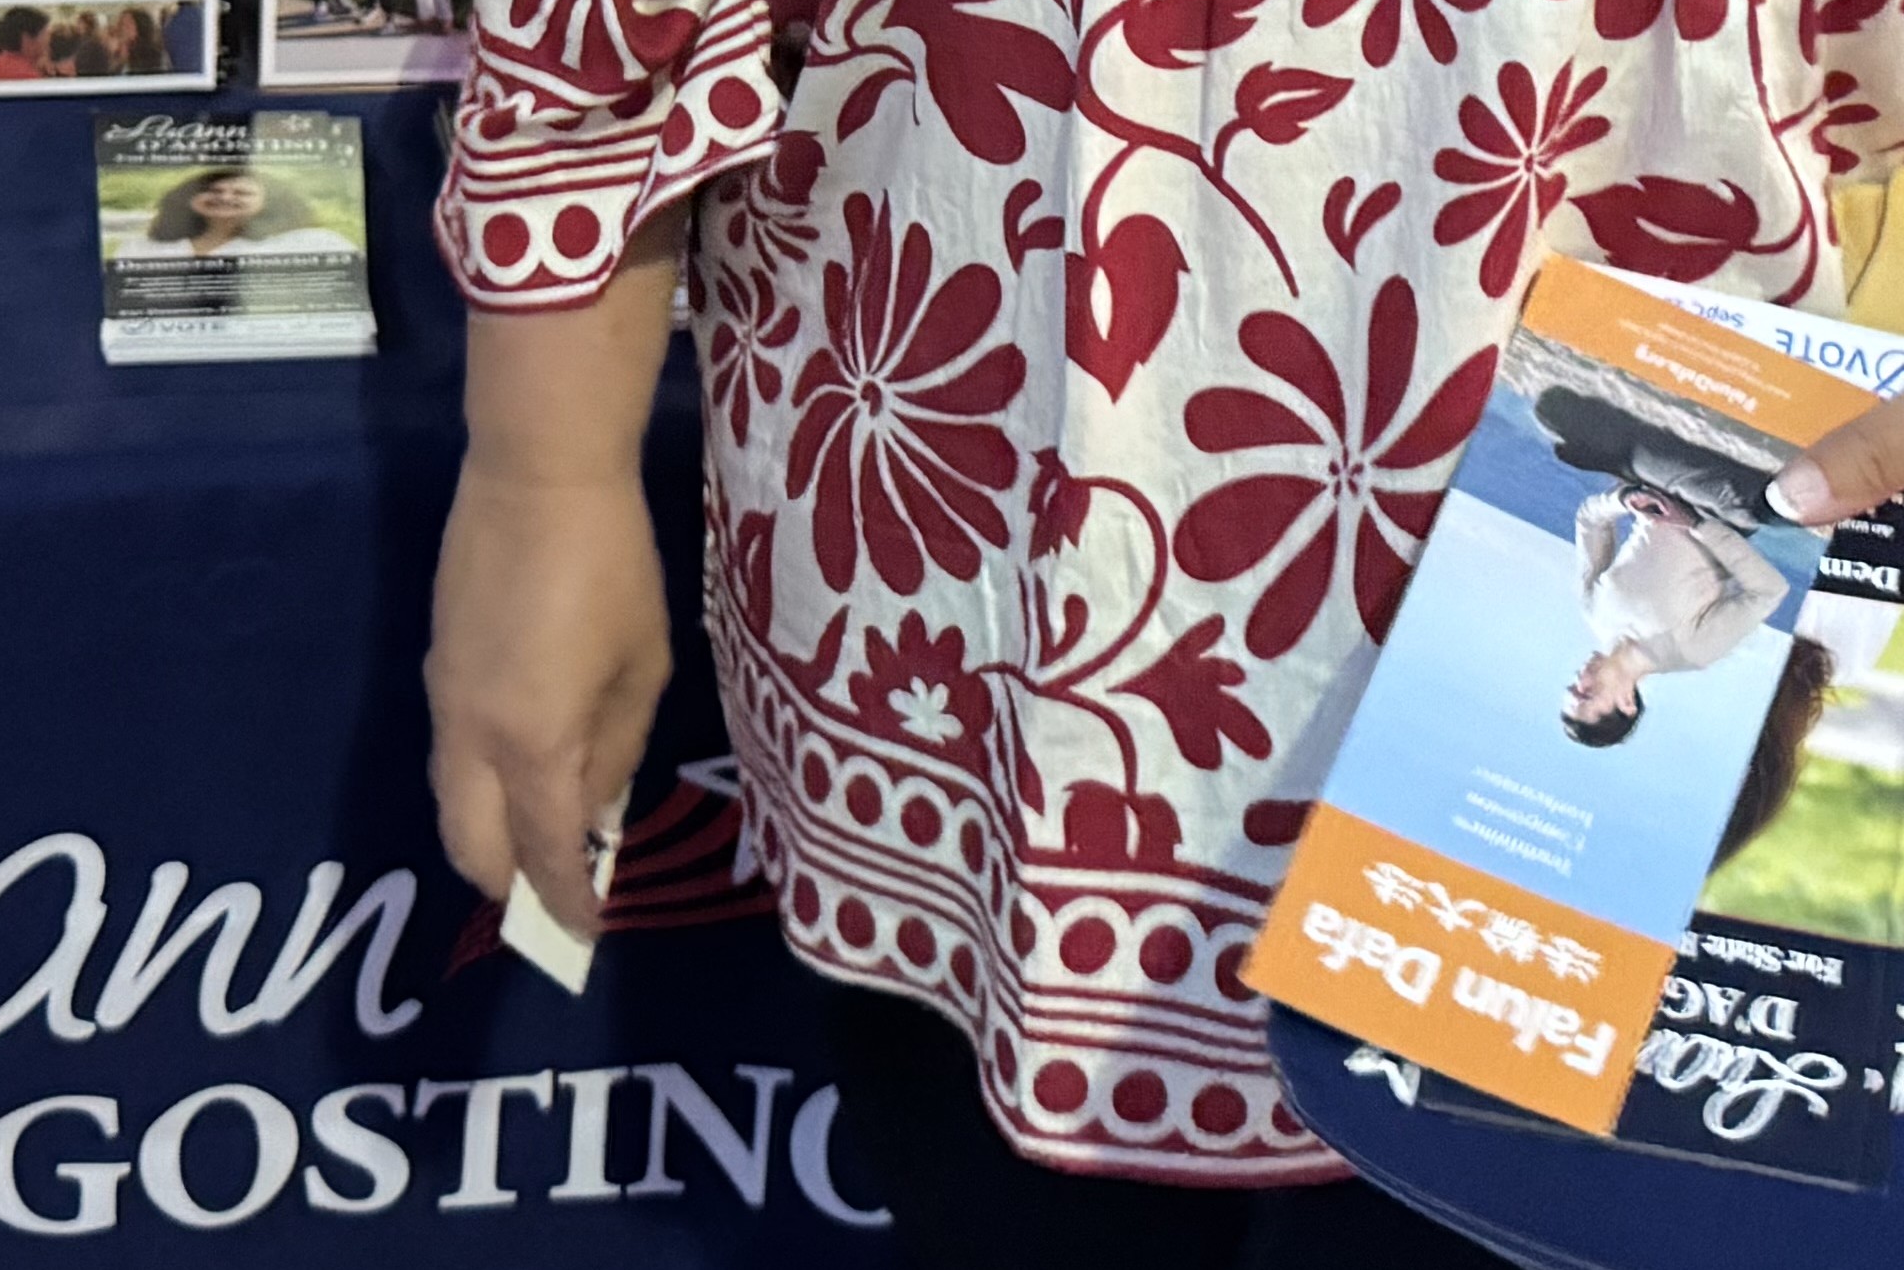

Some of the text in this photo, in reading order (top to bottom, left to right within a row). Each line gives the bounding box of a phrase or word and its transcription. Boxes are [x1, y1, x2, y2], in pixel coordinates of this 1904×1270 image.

[1775, 327, 1870, 378] VOTE
[1302, 900, 1617, 1079] Falun Dafa
